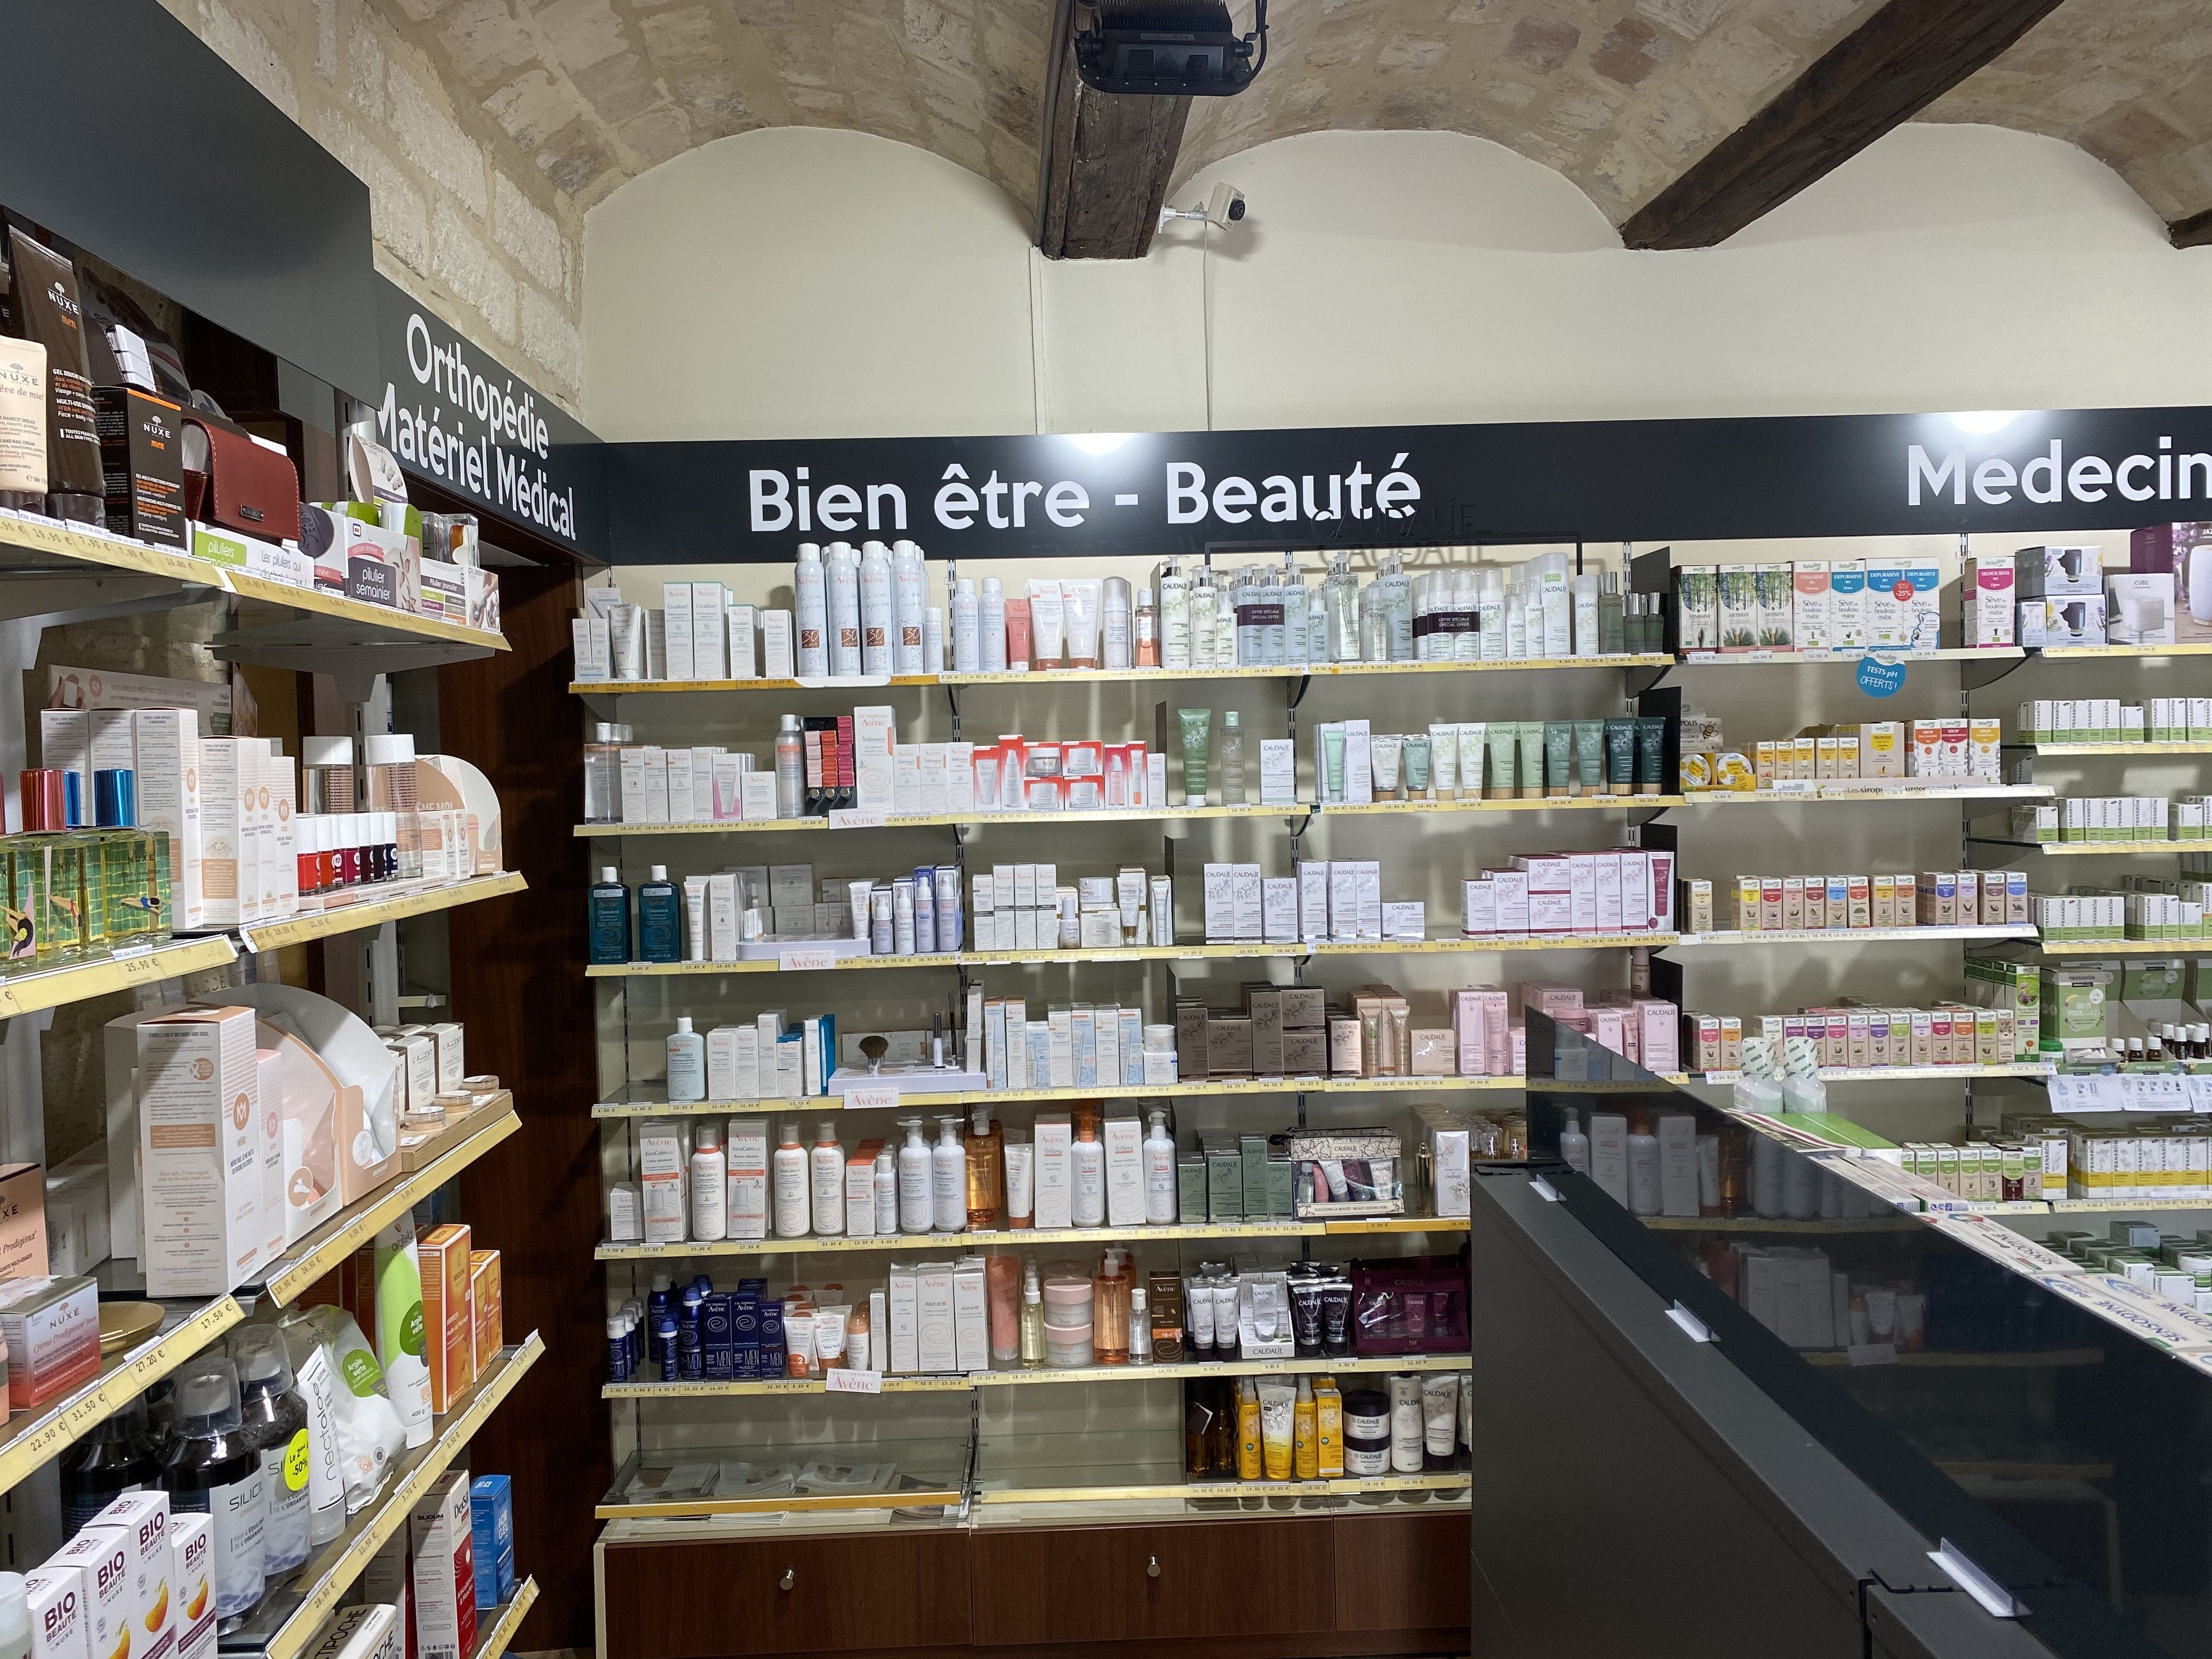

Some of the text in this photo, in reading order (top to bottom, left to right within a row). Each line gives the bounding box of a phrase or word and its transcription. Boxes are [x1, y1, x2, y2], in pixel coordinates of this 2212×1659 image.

[48, 290, 79, 315] NUXE
[61, 314, 77, 329] men
[0, 372, 38, 386] NUXE
[407, 314, 549, 460] Orthopédie
[0, 386, 16, 394] êve
[18, 387, 27, 396] de
[143, 423, 171, 438] NUXE
[151, 439, 165, 450] men
[379, 382, 576, 541] Matériel Médical
[750, 467, 907, 532] Bien
[934, 463, 1090, 529] être
[1166, 453, 1421, 523] Beauté
[32, 528, 72, 545] 19.90 €
[79, 536, 111, 551] 7.90 €
[208, 540, 234, 558] piluliers
[262, 550, 270, 563] Les
[273, 555, 291, 569] piluliers
[363, 567, 385, 583] pilulier
[357, 583, 390, 600] semainier
[802, 630, 819, 643] 30
[842, 629, 857, 641] 30
[867, 628, 883, 641] 30
[904, 627, 919, 640] 30
[1867, 665, 1886, 675] TESTS
[838, 814, 877, 826] Avène
[127, 854, 155, 863] NUXE
[126, 958, 159, 972] 25.90 €
[787, 957, 828, 969] Avène
[852, 1094, 891, 1106] Avène
[3, 1232, 36, 1254] Prodigieux
[275, 1279, 291, 1295] 19.90
[1156, 1285, 1176, 1294] Avène
[50, 1308, 80, 1329] NUXE
[201, 1303, 233, 1329] 17.50 €
[2094, 1300, 2188, 1342] SENSODYNE
[33, 1336, 52, 1353] Crème
[136, 1350, 165, 1372] 27.20 €
[348, 1358, 363, 1372] Argile
[687, 1353, 702, 1370] MEN
[716, 1352, 731, 1367] MEN
[744, 1350, 759, 1366] MEN
[770, 1352, 783, 1365] MEN
[353, 1364, 367, 1376] verte
[834, 1378, 873, 1390] Avène
[72, 1393, 105, 1422] 31.50 €
[30, 1421, 66, 1452] 22.90 €
[292, 1458, 308, 1476] -50%
[109, 1500, 131, 1515] BIO
[139, 1511, 164, 1546] BIO
[66, 1539, 90, 1556] BIO
[140, 1528, 165, 1556] BEAUTÉ
[185, 1533, 206, 1562] BIO
[186, 1545, 207, 1570] BEAUTÉ
[98, 1550, 125, 1589] BIO
[99, 1568, 126, 1599] BEAUTÉ
[107, 1585, 123, 1604] NUXE
[44, 1592, 76, 1632] BIO
[47, 1611, 77, 1643] BEAUTÉ
[55, 1628, 74, 1648] NUXE
